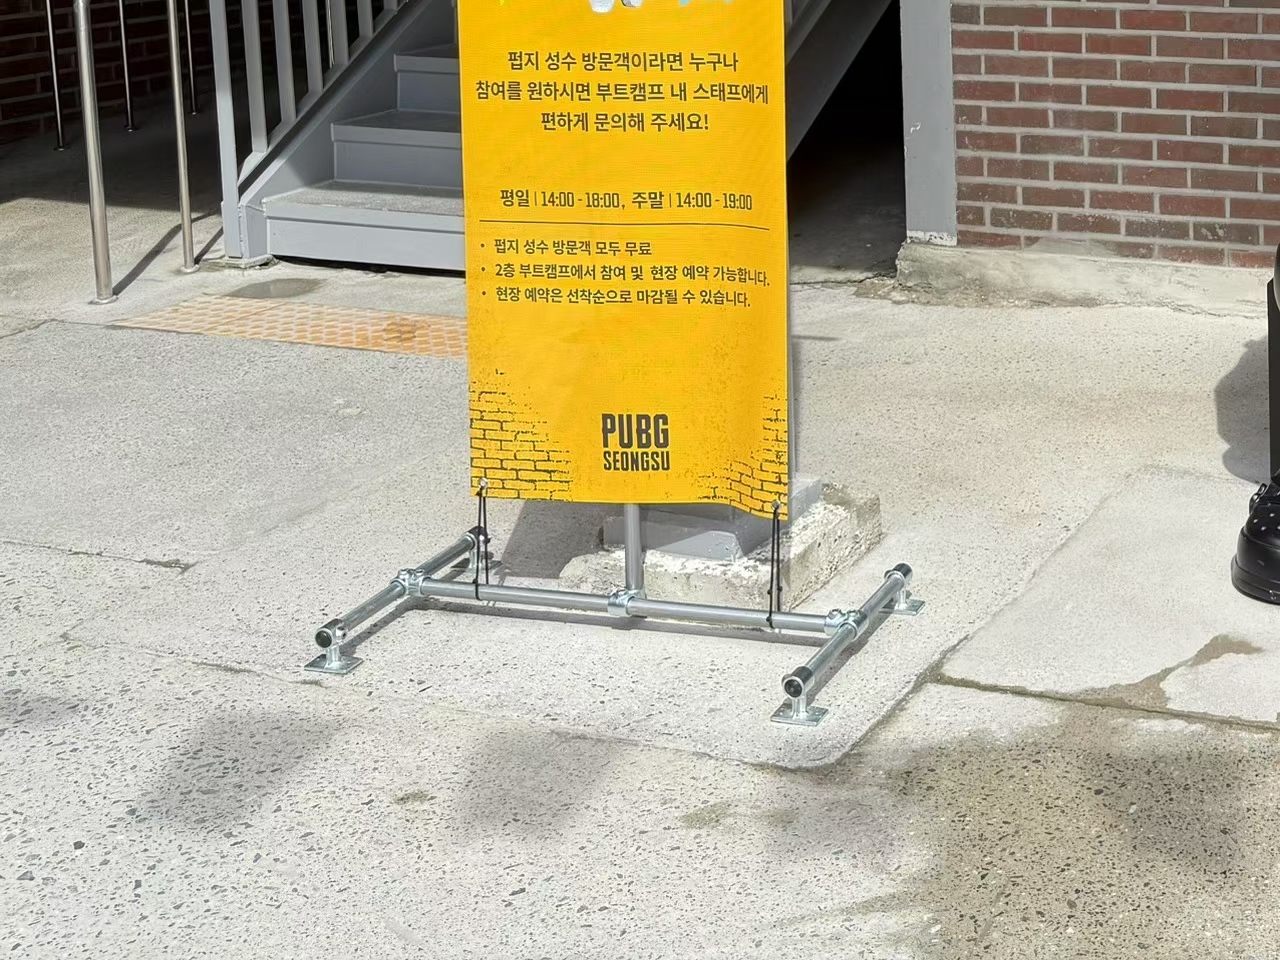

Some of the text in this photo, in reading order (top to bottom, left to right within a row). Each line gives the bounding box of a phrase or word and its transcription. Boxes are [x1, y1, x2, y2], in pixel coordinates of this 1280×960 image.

[508, 51, 738, 72] 펍지 성수 방문객이라면 누구나
[476, 81, 768, 104] 참여를 원하시면 부트캠프 내 스태프에게
[542, 112, 708, 132] 편하게 문의해 주세요!
[501, 189, 529, 207] 평일
[632, 192, 664, 209] 주말
[723, 193, 752, 210] 19:00
[495, 239, 652, 256] 펍지 성수 방문객 모두 무료
[495, 263, 769, 286] 2층 부트캠프에서 참여 및 현장 예약 가능합니다.
[496, 287, 750, 307] 현장 예약은 선착순으로 마감될 수 있습니다.
[602, 414, 669, 449] PUBG
[604, 451, 670, 471] SEONGSU
